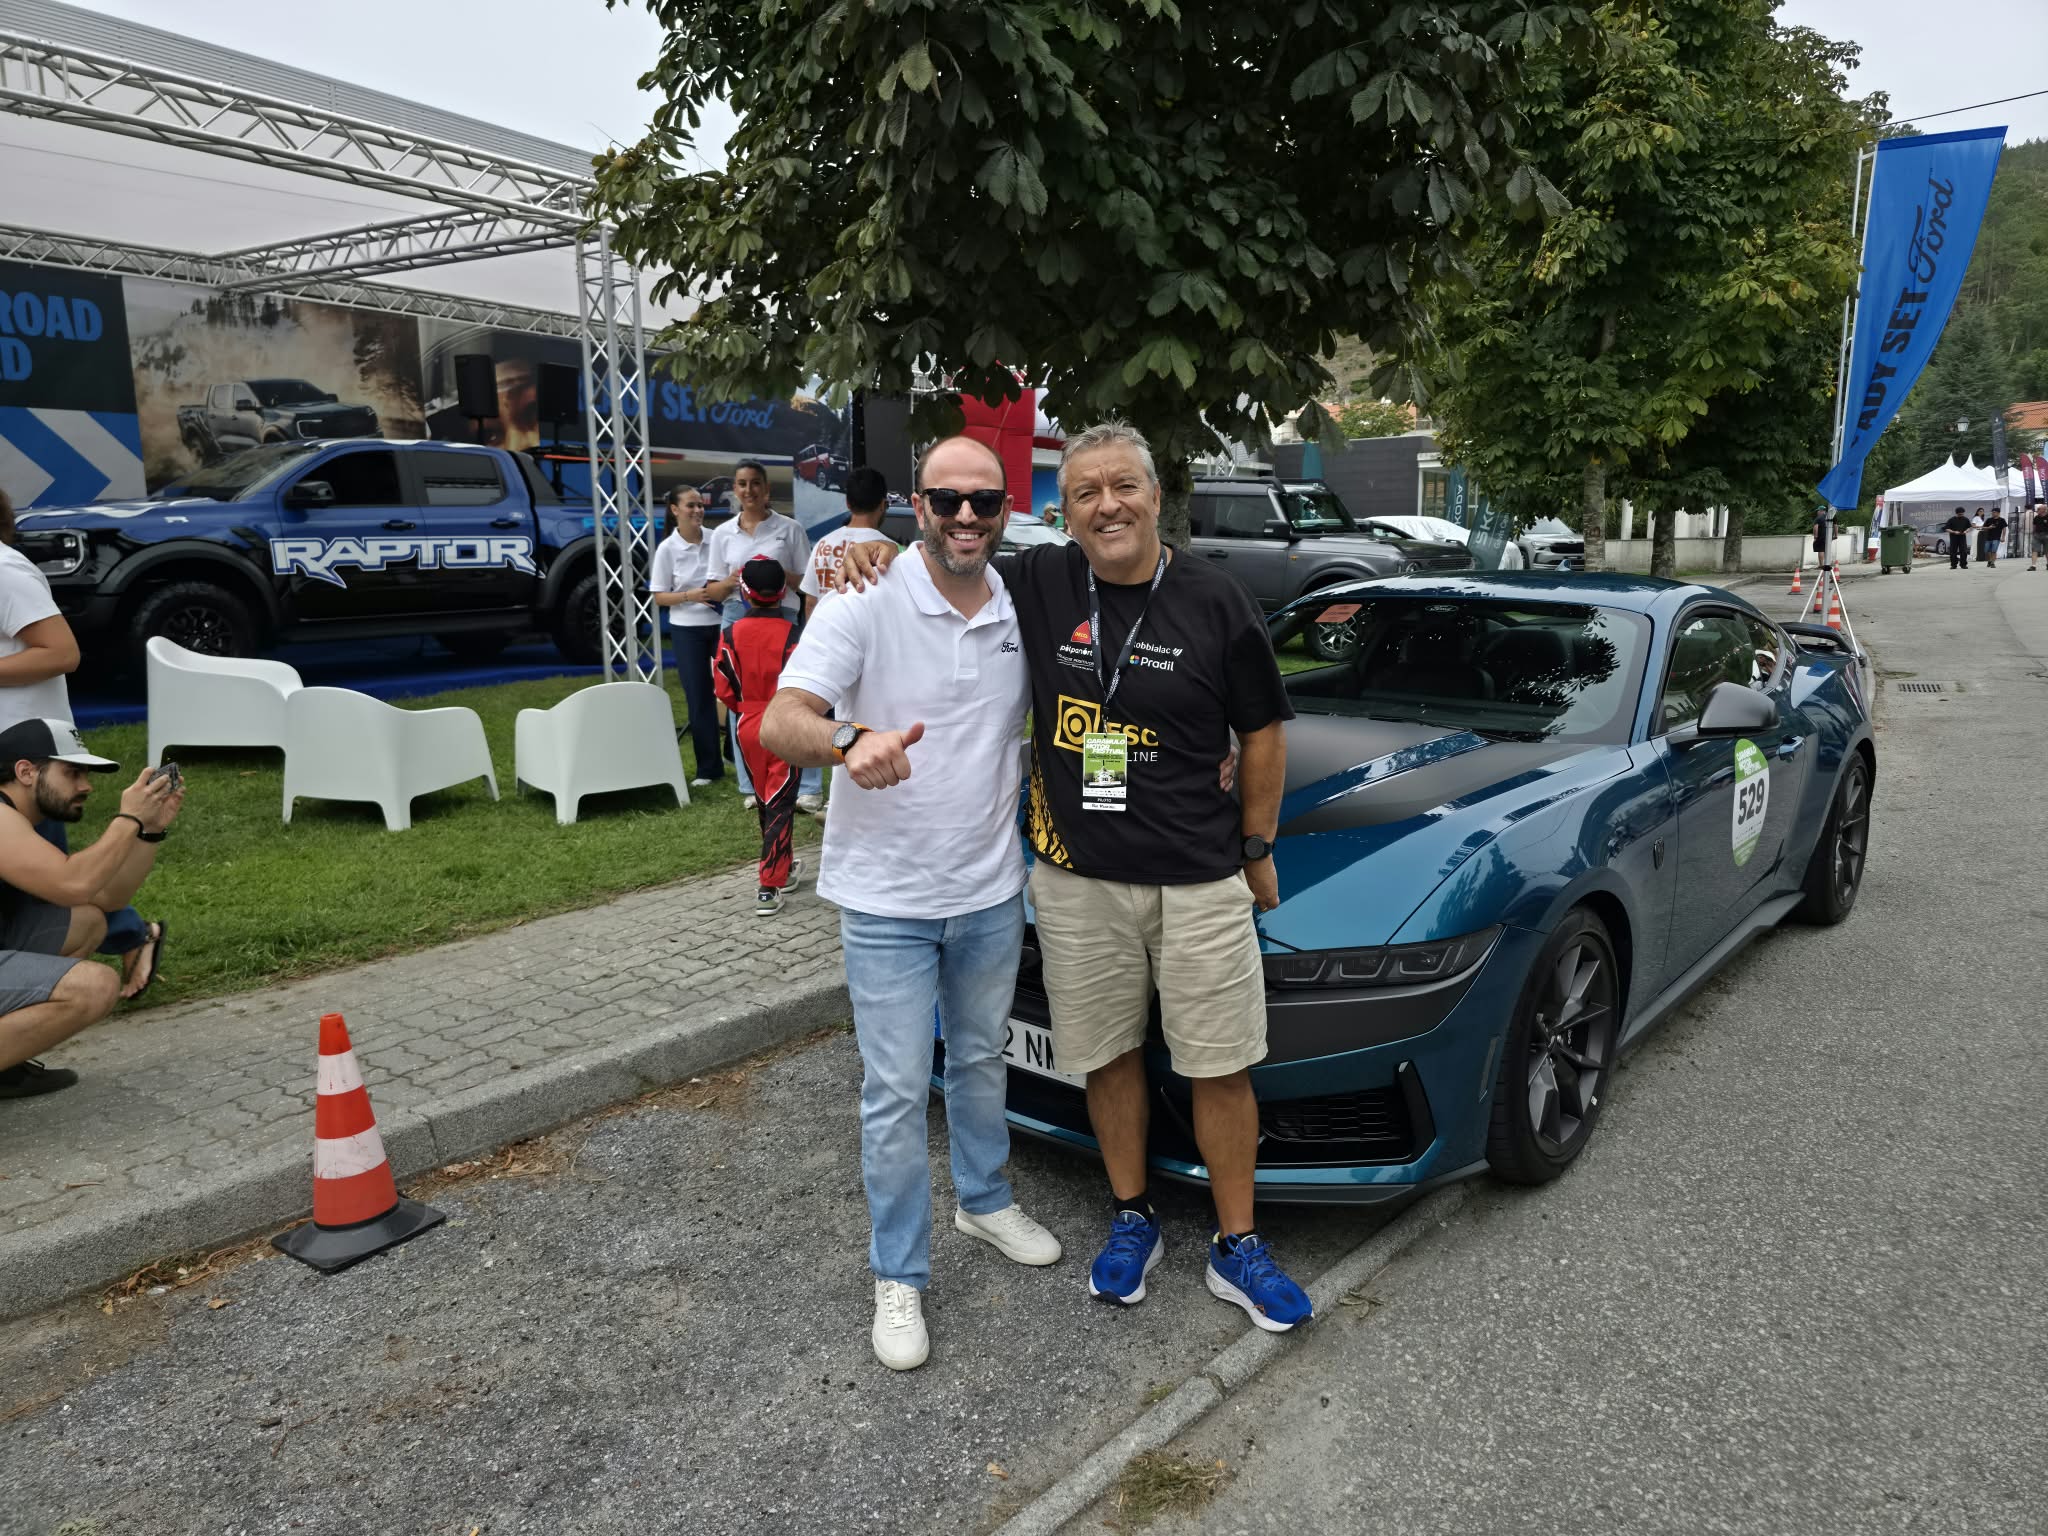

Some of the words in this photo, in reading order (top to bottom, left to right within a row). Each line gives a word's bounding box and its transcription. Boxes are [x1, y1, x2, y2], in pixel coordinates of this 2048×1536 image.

[1857, 360, 1897, 431] ADY
[1881, 288, 1928, 354] SET
[1908, 178, 1954, 284] Ford
[269, 536, 546, 589] RAPTOR
[816, 569, 836, 588] TE
[1001, 641, 1019, 653] Ford
[1134, 641, 1171, 654] obbialac
[1140, 657, 1175, 671] Pradil
[1127, 751, 1158, 762] LINE
[1738, 778, 1765, 826] 529
